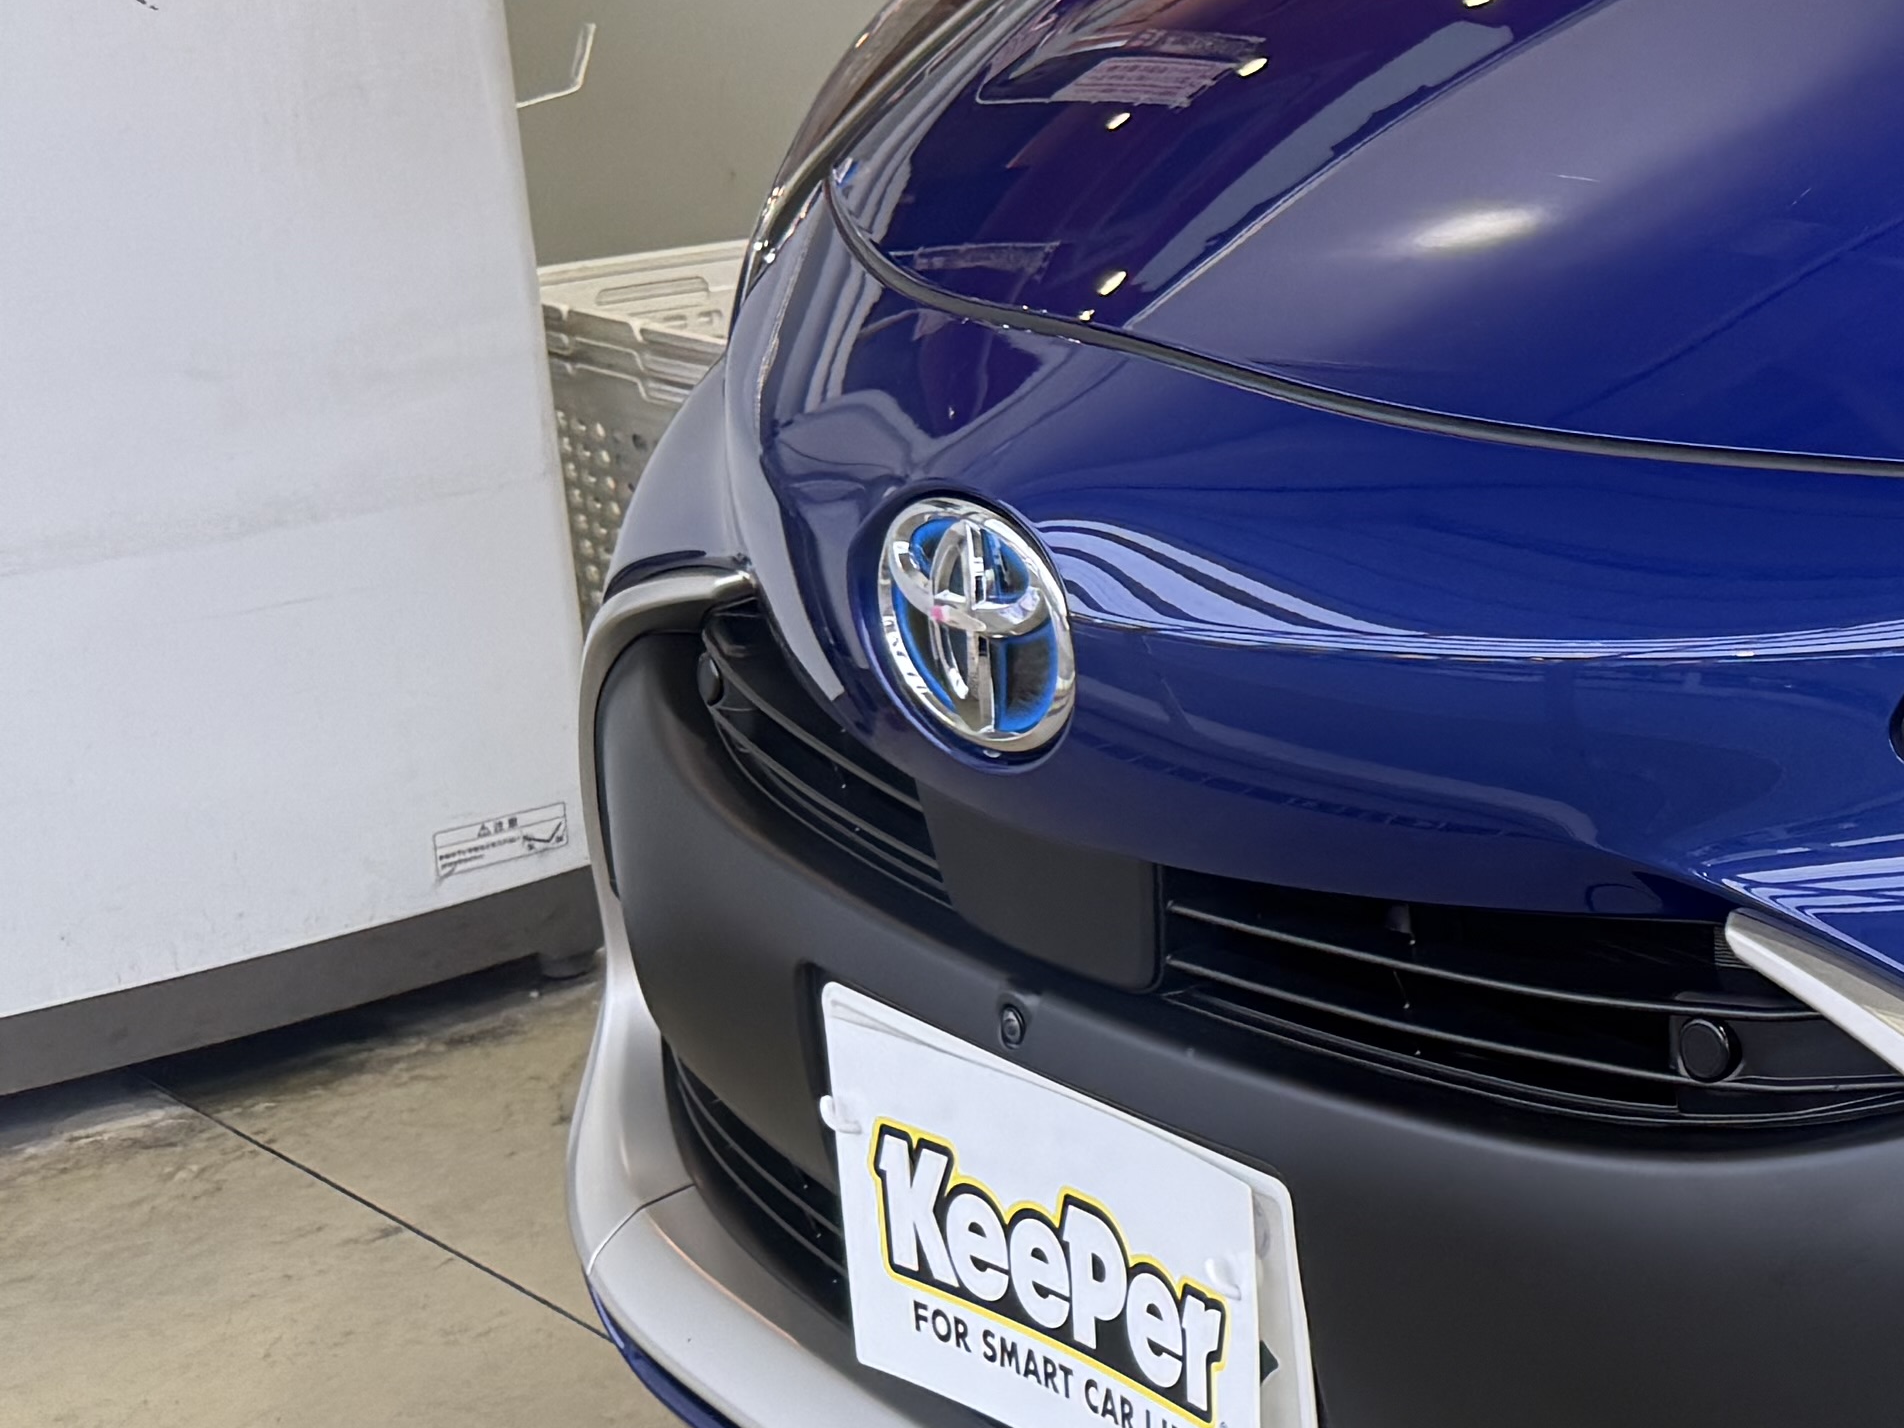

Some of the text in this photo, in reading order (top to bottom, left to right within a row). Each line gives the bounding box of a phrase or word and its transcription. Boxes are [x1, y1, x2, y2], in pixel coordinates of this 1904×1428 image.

[872, 1124, 1227, 1422] KeePer
[912, 1299, 972, 1355] FOR
[981, 1331, 1075, 1400] SMART
